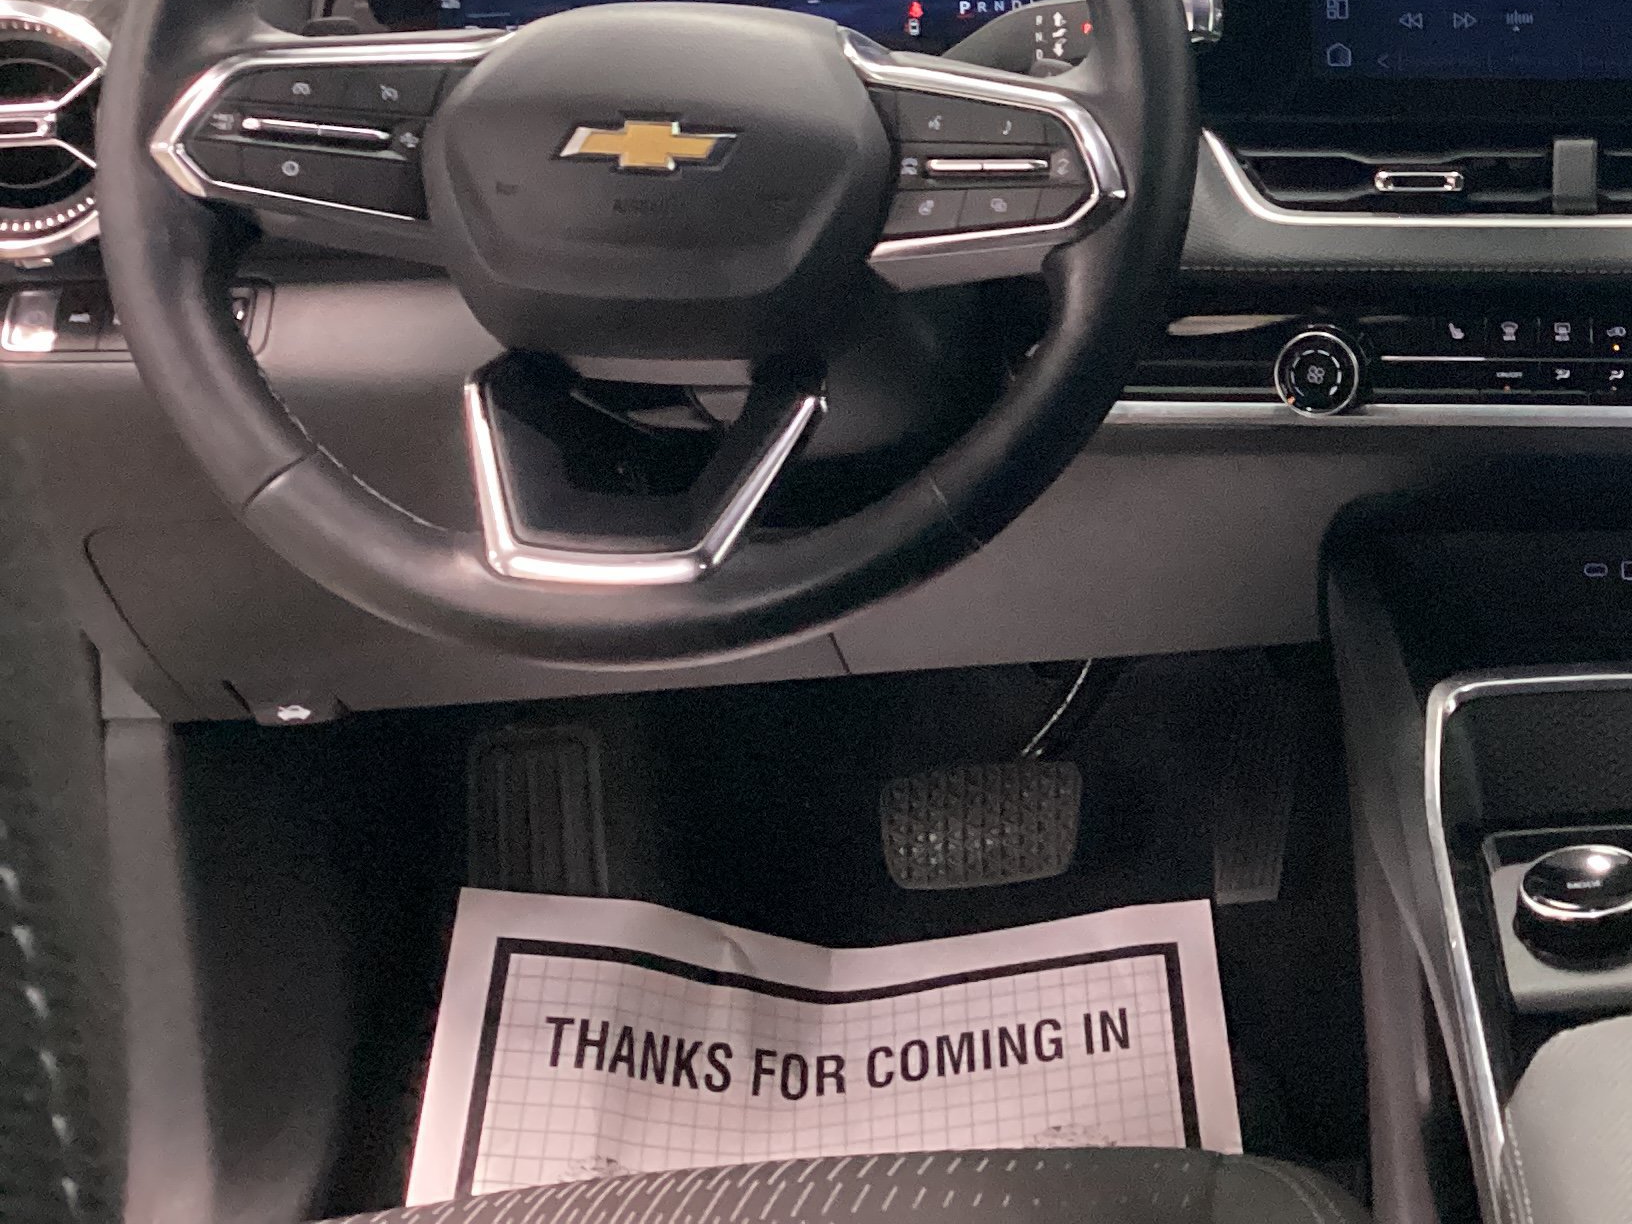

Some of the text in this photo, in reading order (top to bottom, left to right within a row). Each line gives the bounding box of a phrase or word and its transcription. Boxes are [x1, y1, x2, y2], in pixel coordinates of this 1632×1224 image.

[545, 1007, 1131, 1100] THANKS FOR COMING IN
